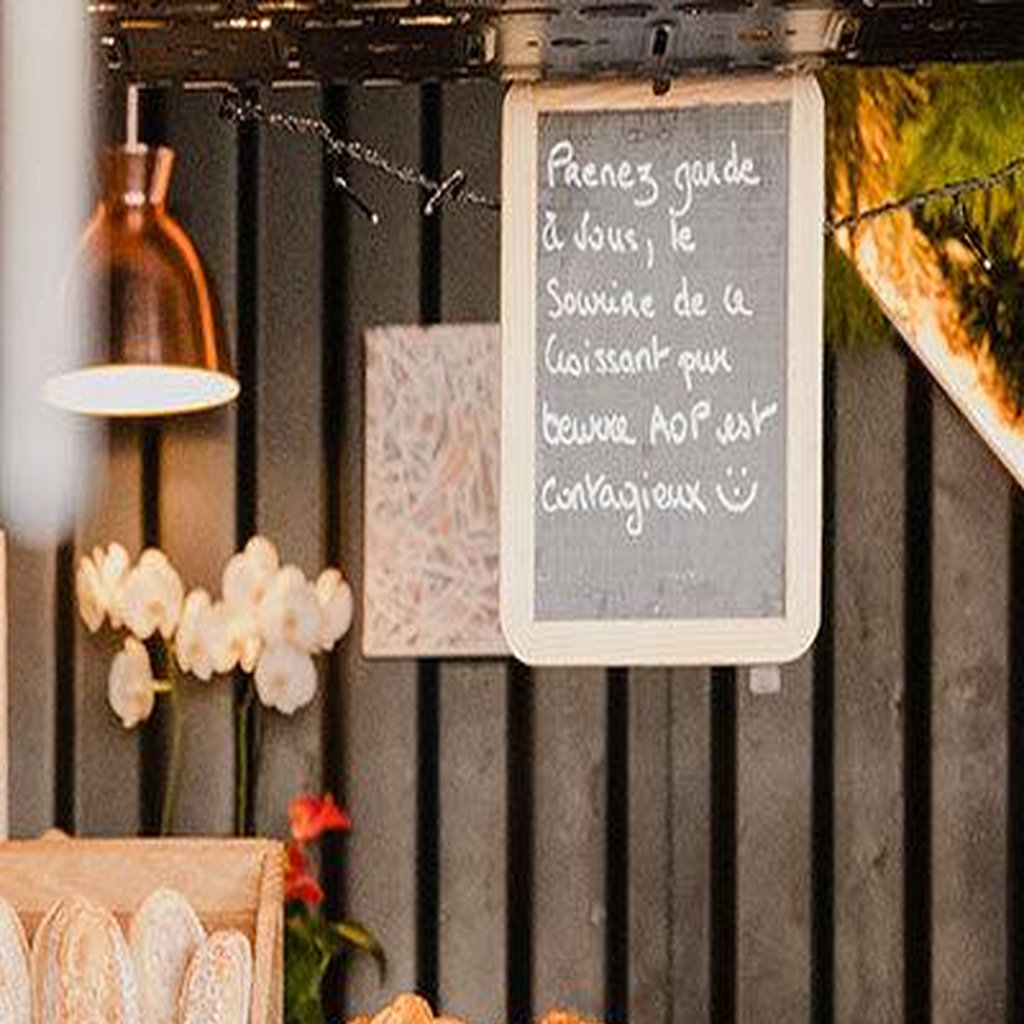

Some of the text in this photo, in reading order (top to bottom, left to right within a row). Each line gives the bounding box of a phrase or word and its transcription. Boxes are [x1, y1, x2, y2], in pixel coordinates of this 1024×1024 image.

[674, 140, 761, 217] garde
[669, 207, 696, 251] le
[546, 276, 655, 319] Sourire
[674, 276, 707, 317] de
[678, 346, 732, 391] pur
[650, 400, 711, 446] AOP
[716, 398, 778, 446] est
